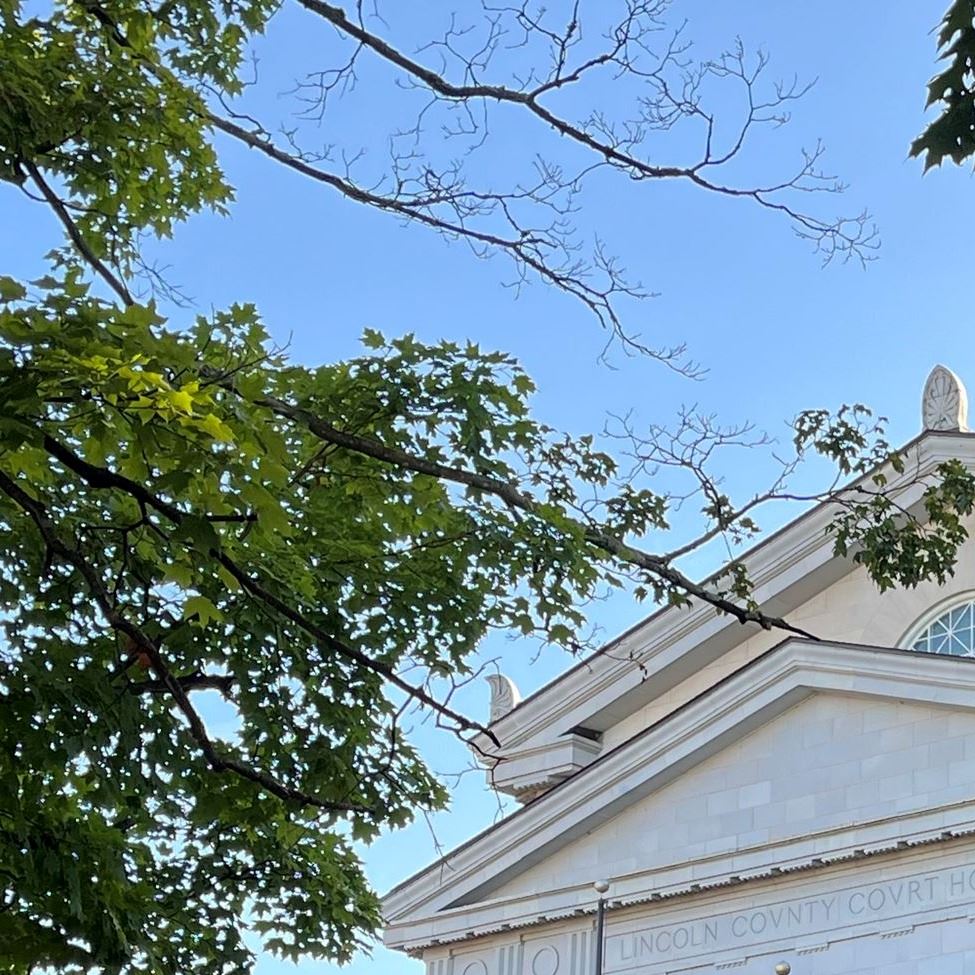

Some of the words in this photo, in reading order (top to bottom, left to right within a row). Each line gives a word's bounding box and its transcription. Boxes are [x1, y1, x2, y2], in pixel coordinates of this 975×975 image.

[620, 921, 718, 960] LINCOLN
[732, 897, 836, 938] COVNTY
[848, 876, 939, 914] COVRT
